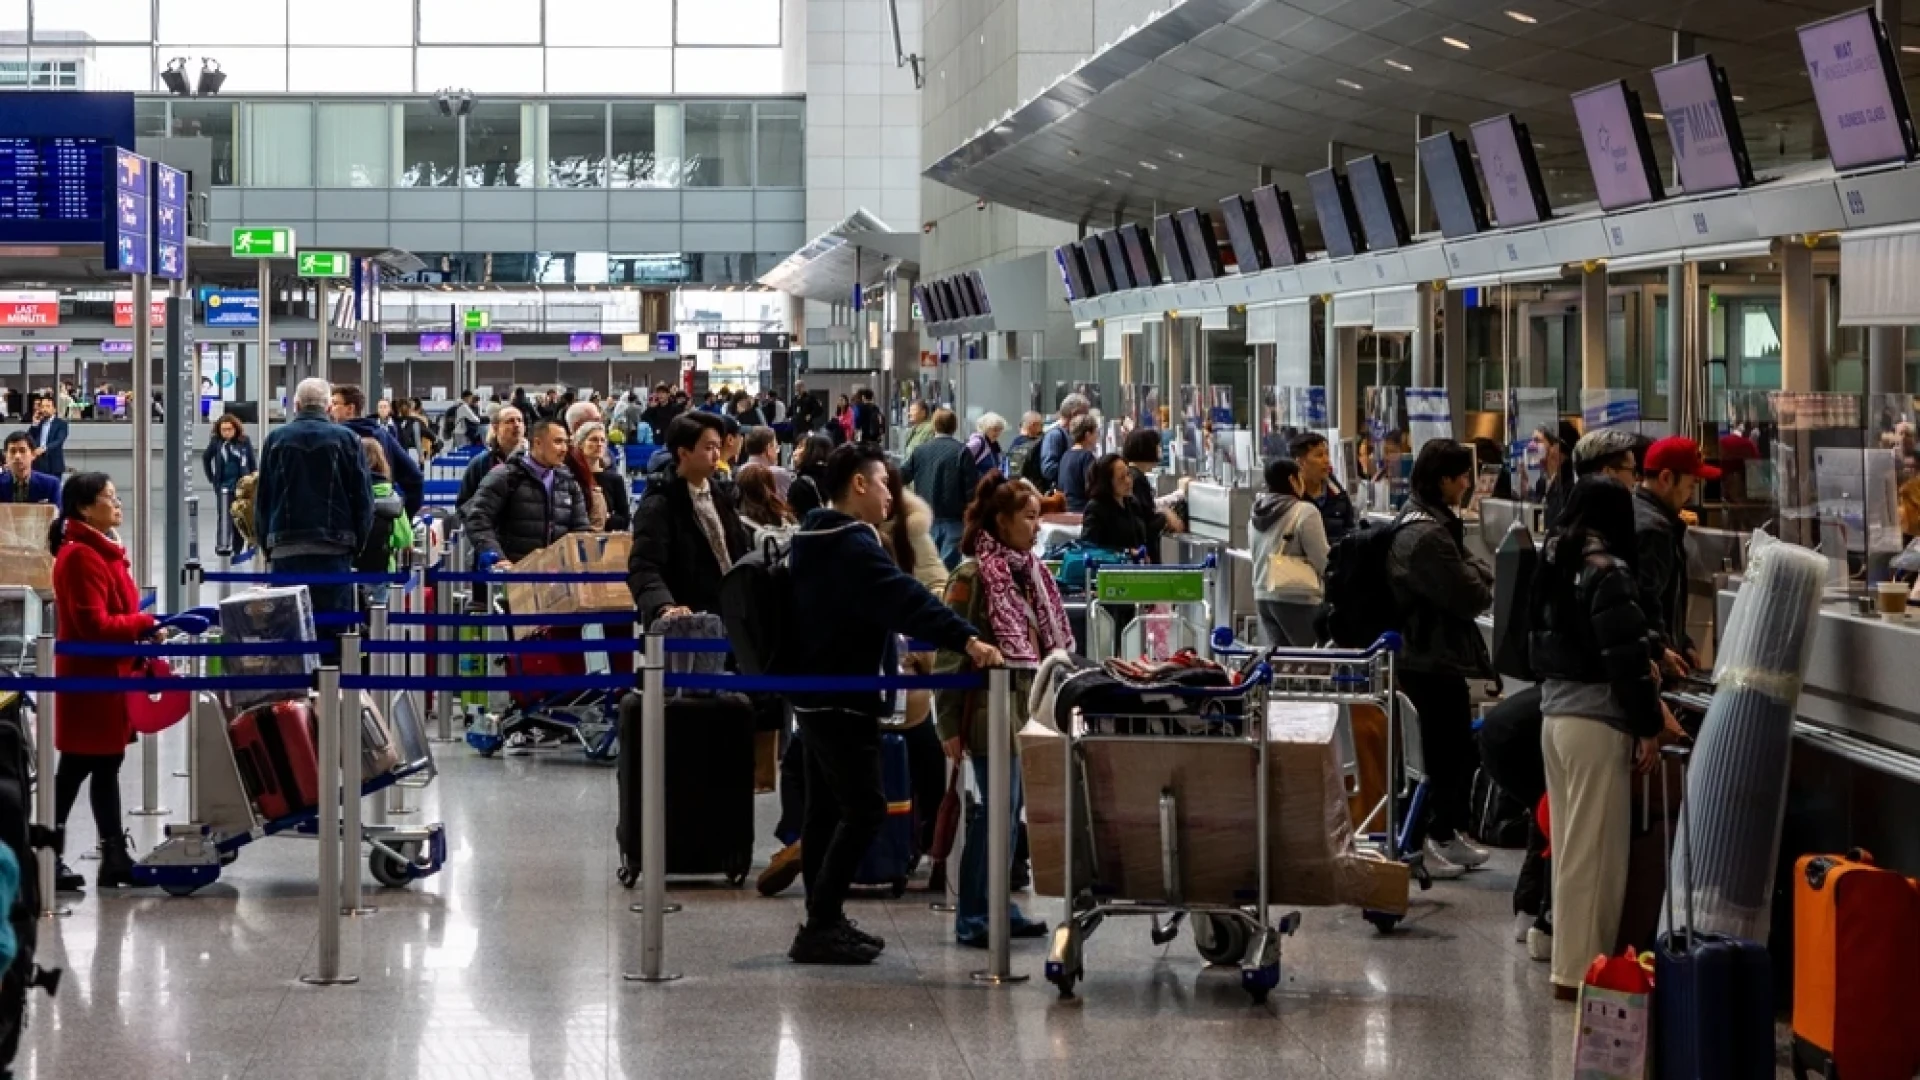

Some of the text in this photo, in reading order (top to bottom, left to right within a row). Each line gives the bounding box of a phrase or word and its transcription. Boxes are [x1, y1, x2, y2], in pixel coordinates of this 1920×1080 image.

[1684, 101, 1726, 142] MIAT
[15, 304, 38, 314] LAST
[116, 304, 133, 314] LAS
[8, 313, 47, 323] MINUTE
